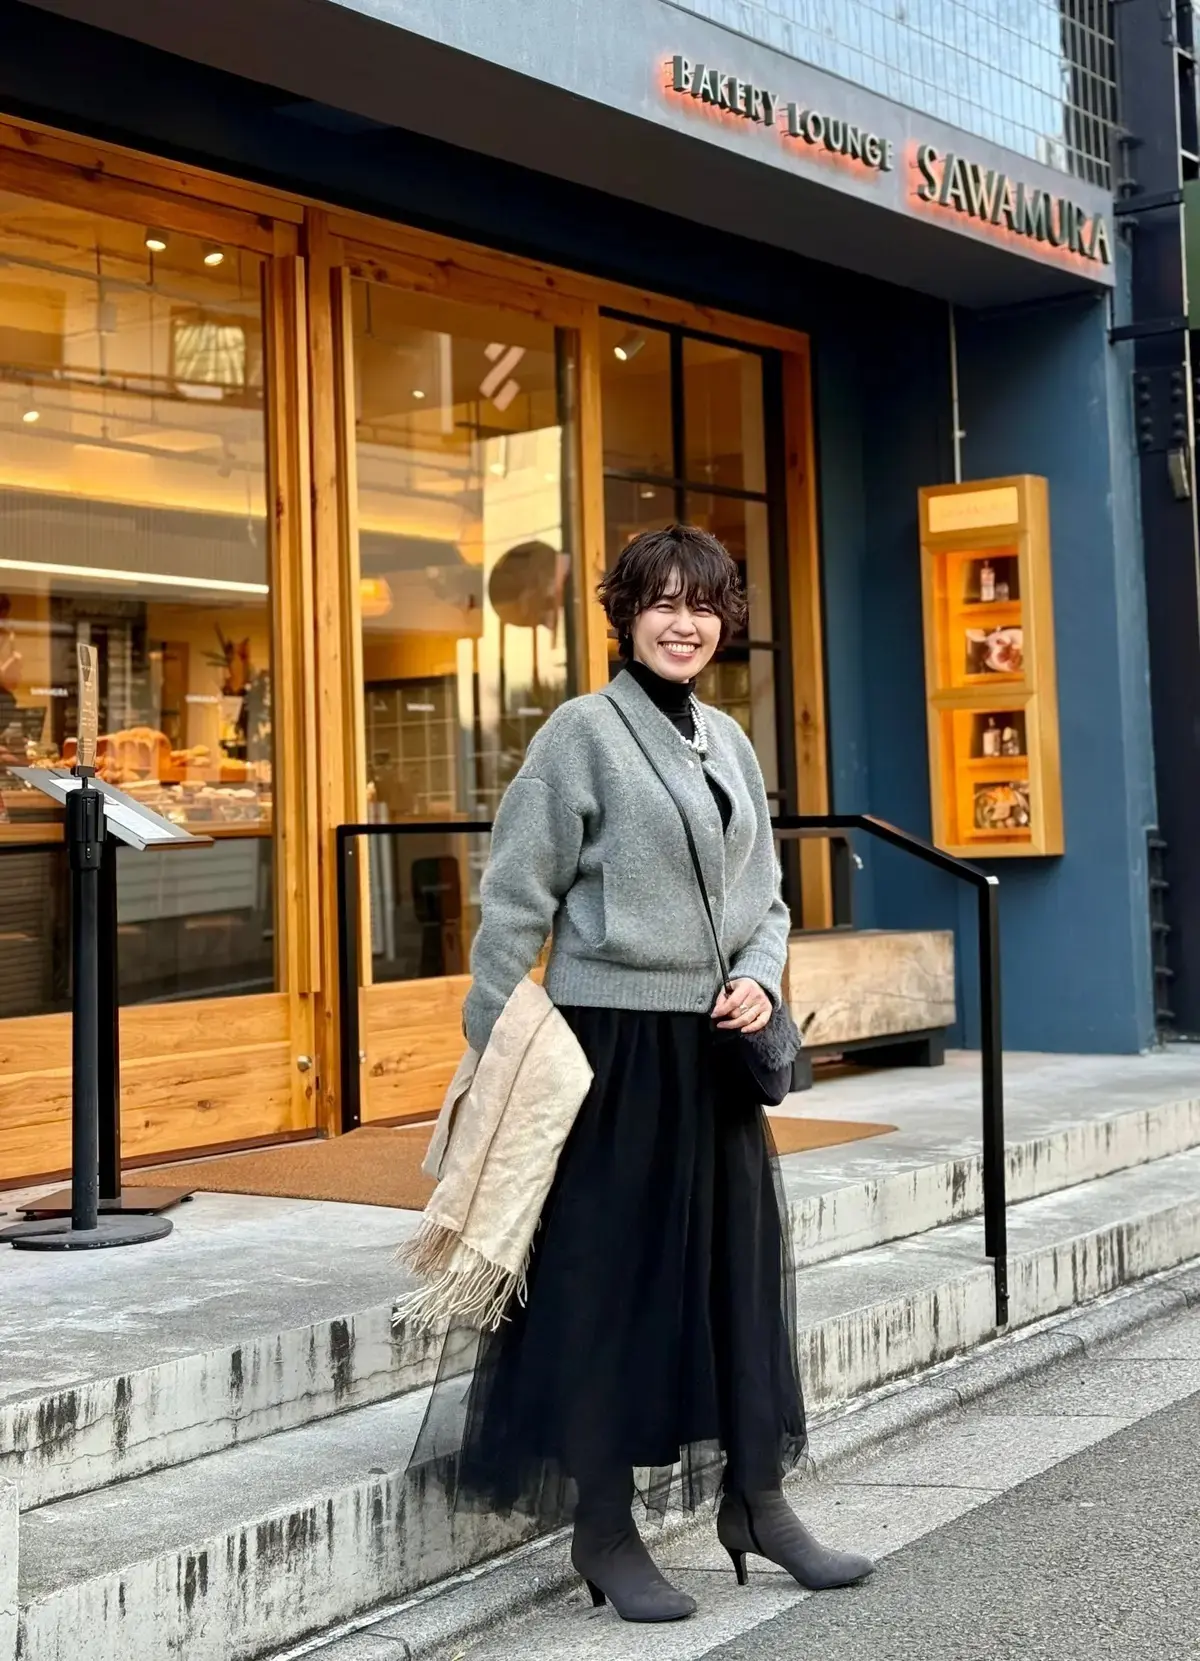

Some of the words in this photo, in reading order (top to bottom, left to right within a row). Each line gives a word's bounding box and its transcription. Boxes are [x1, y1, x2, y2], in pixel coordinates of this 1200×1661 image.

[673, 55, 779, 126] BAKERY
[787, 102, 894, 172] LOUNGE
[917, 144, 1112, 264] SAWAMURA
